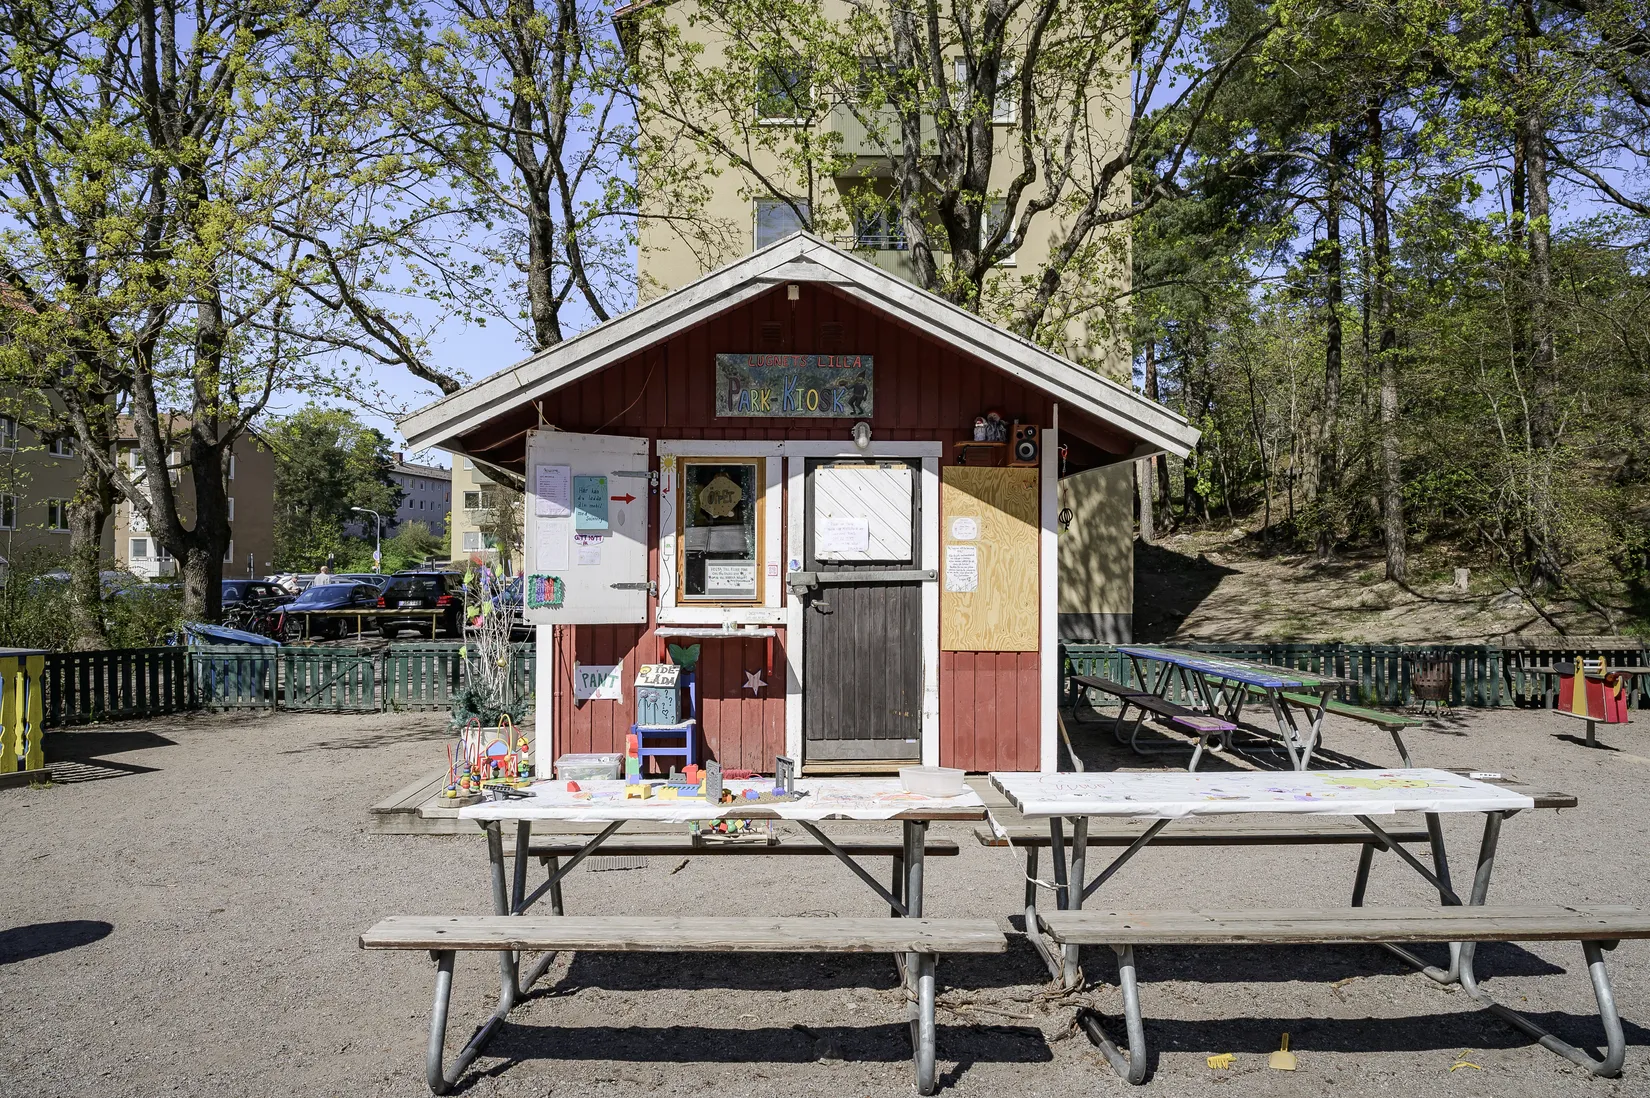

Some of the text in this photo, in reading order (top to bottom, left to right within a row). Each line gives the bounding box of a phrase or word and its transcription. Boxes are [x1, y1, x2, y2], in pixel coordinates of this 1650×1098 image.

[748, 355, 862, 368] LUGNETS LILLA
[582, 673, 619, 689] PANT
[644, 674, 675, 685] LÅDA
